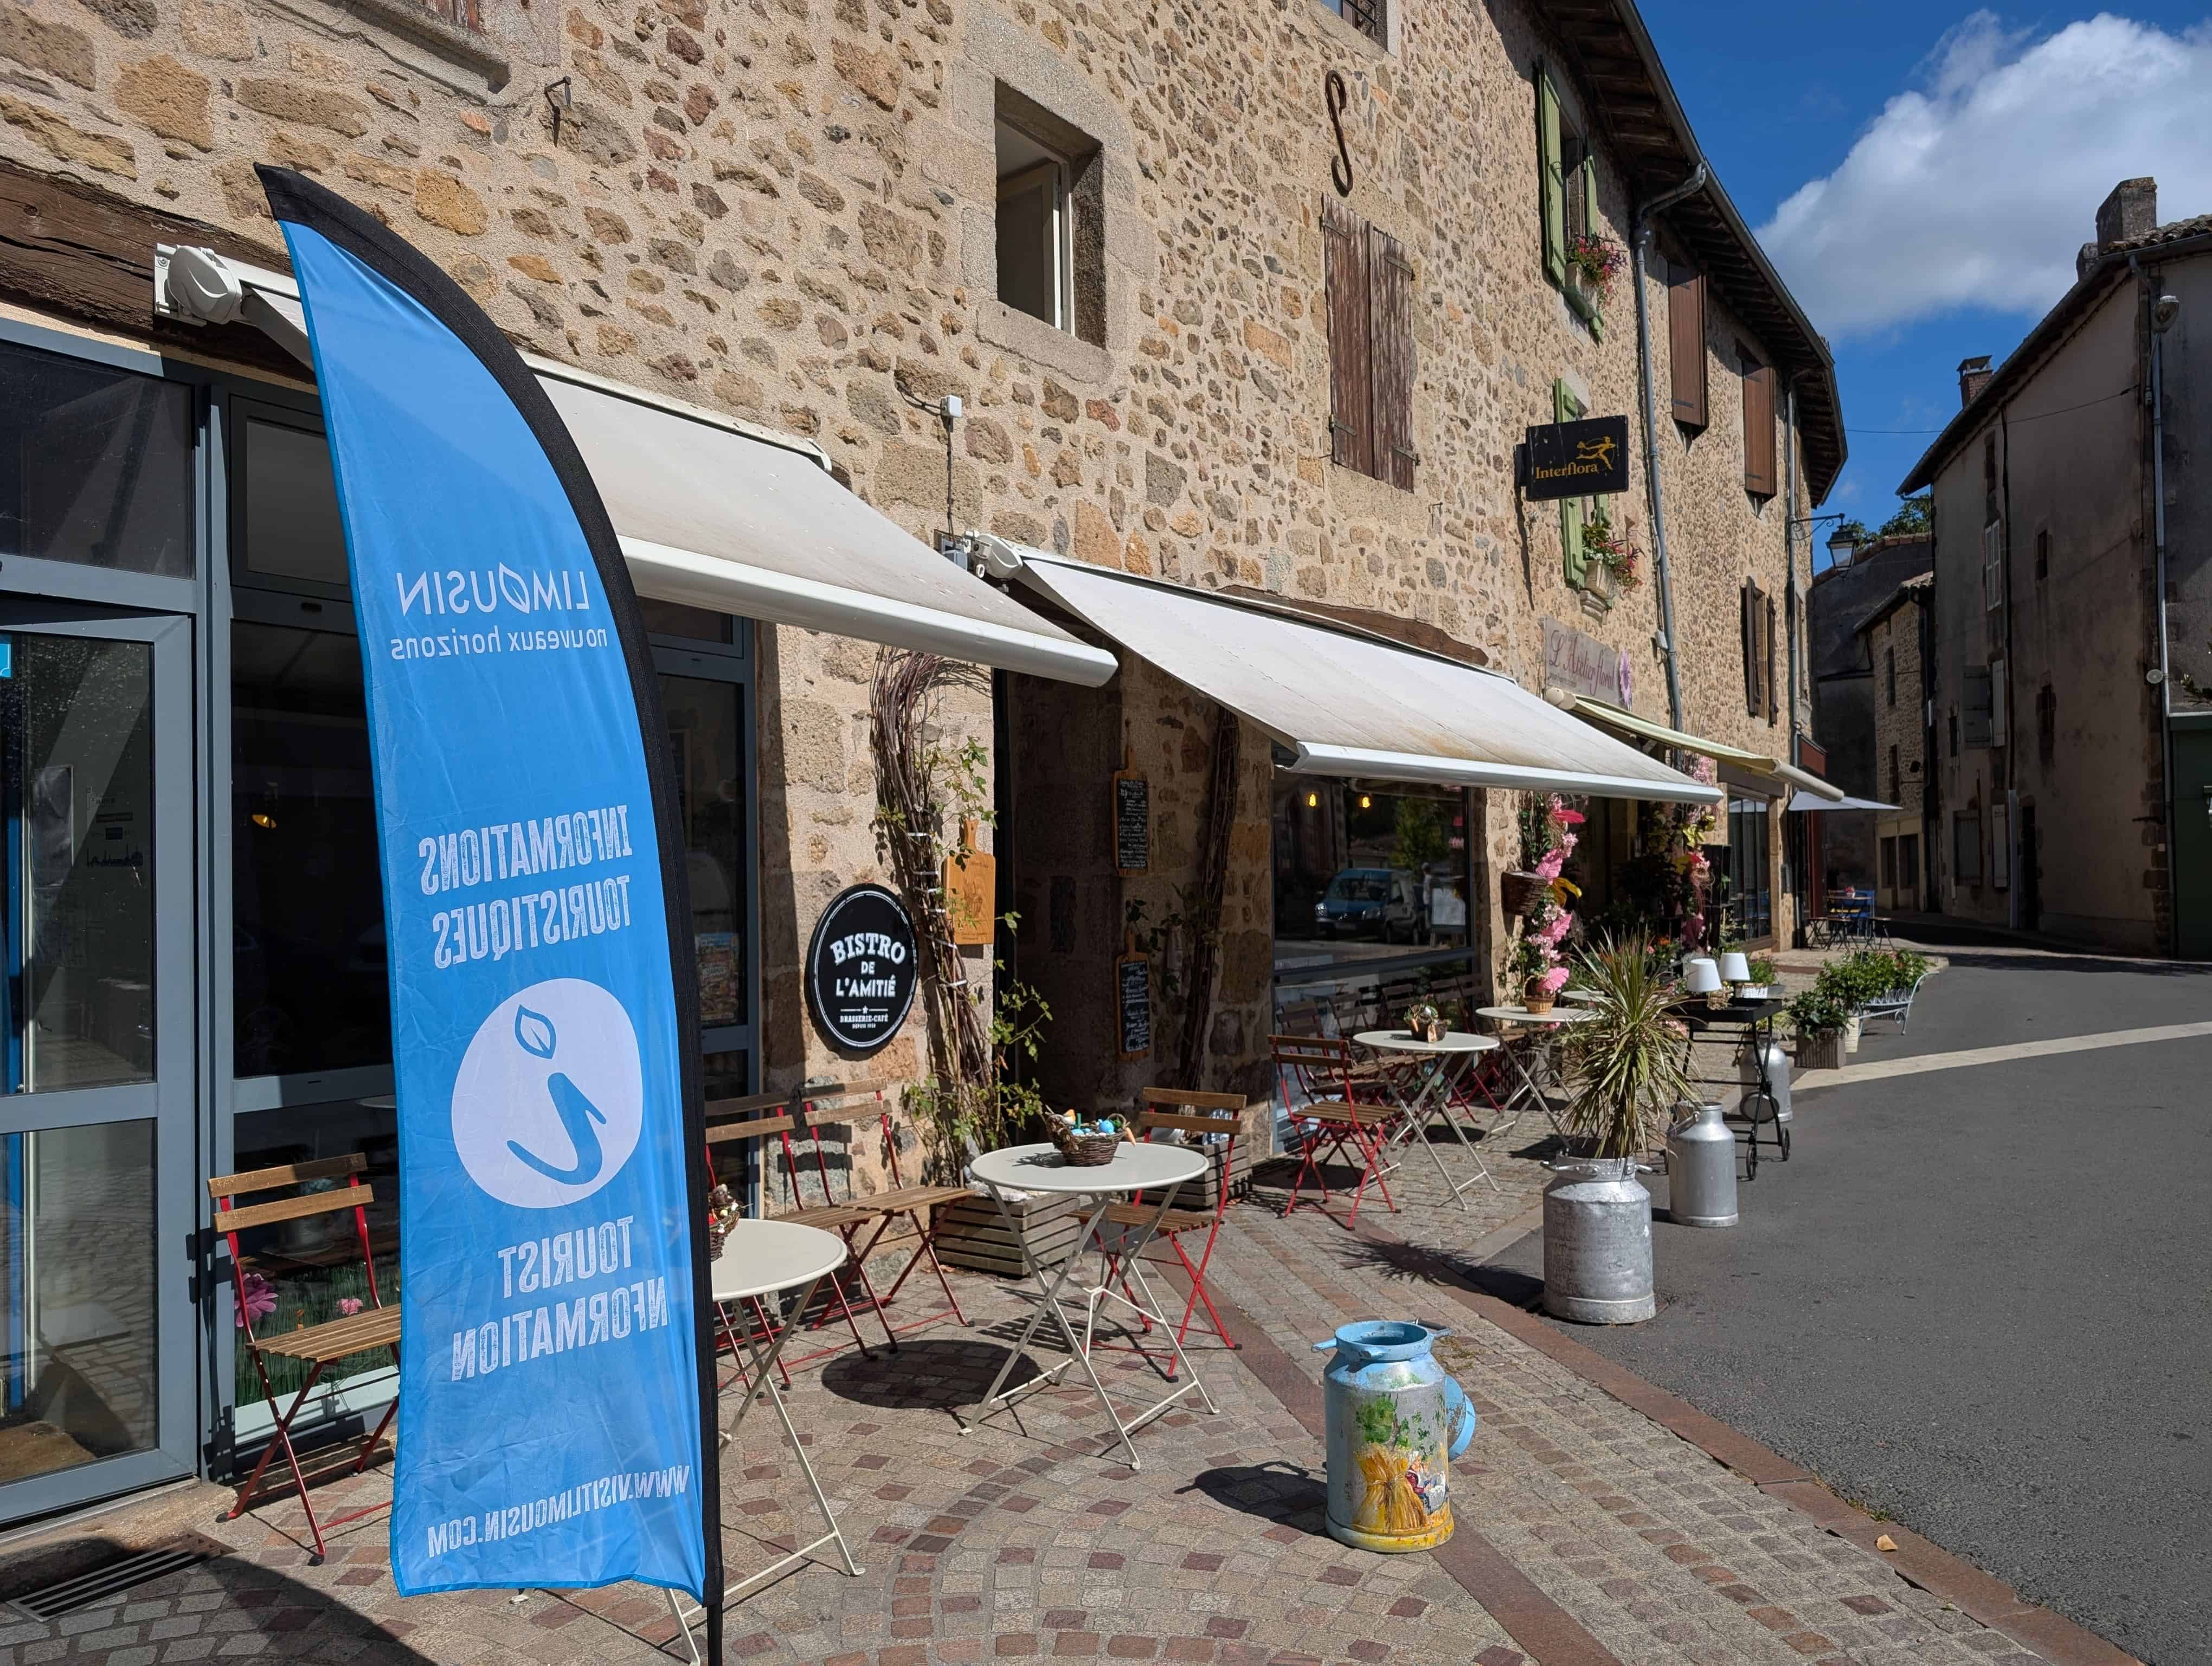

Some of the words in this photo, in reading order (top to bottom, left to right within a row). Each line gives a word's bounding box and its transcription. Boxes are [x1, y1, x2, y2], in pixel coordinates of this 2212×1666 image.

[1535, 462, 1598, 479] Interflora
[829, 932, 906, 966] BISTRO
[860, 961, 875, 975] DE
[835, 974, 896, 998] L'AMITIÉ
[840, 1013, 889, 1023] BRASSERIE-CAFÉ
